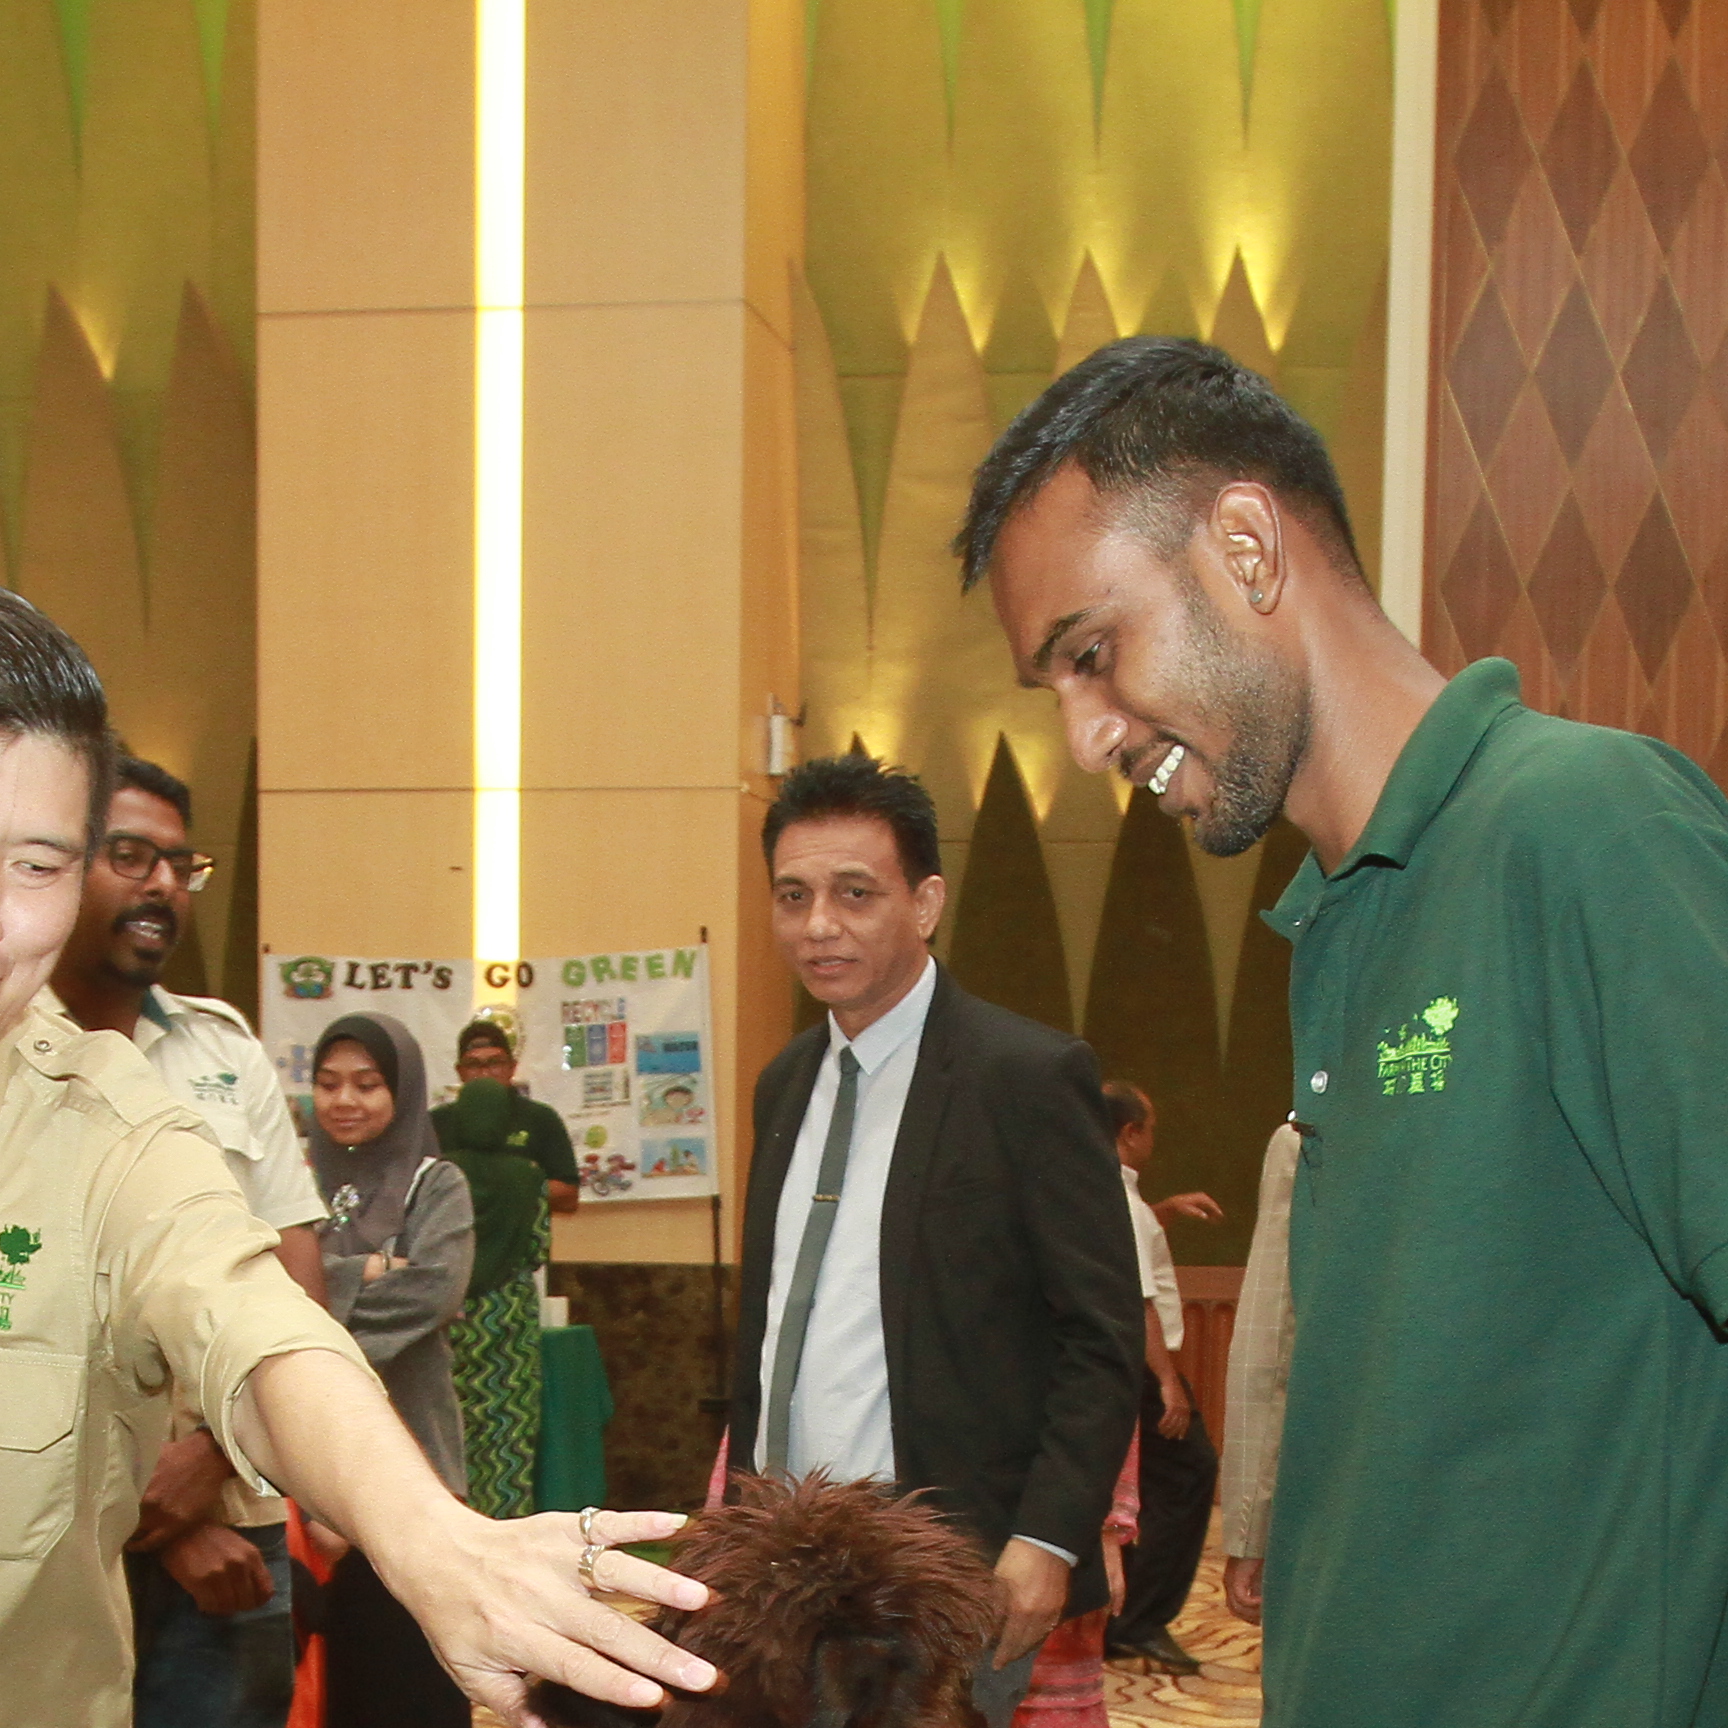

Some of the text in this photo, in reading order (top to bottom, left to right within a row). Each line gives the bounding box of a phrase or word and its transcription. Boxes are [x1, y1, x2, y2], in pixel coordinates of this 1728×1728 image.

[343, 949, 697, 990] LET'S GO GREEN
